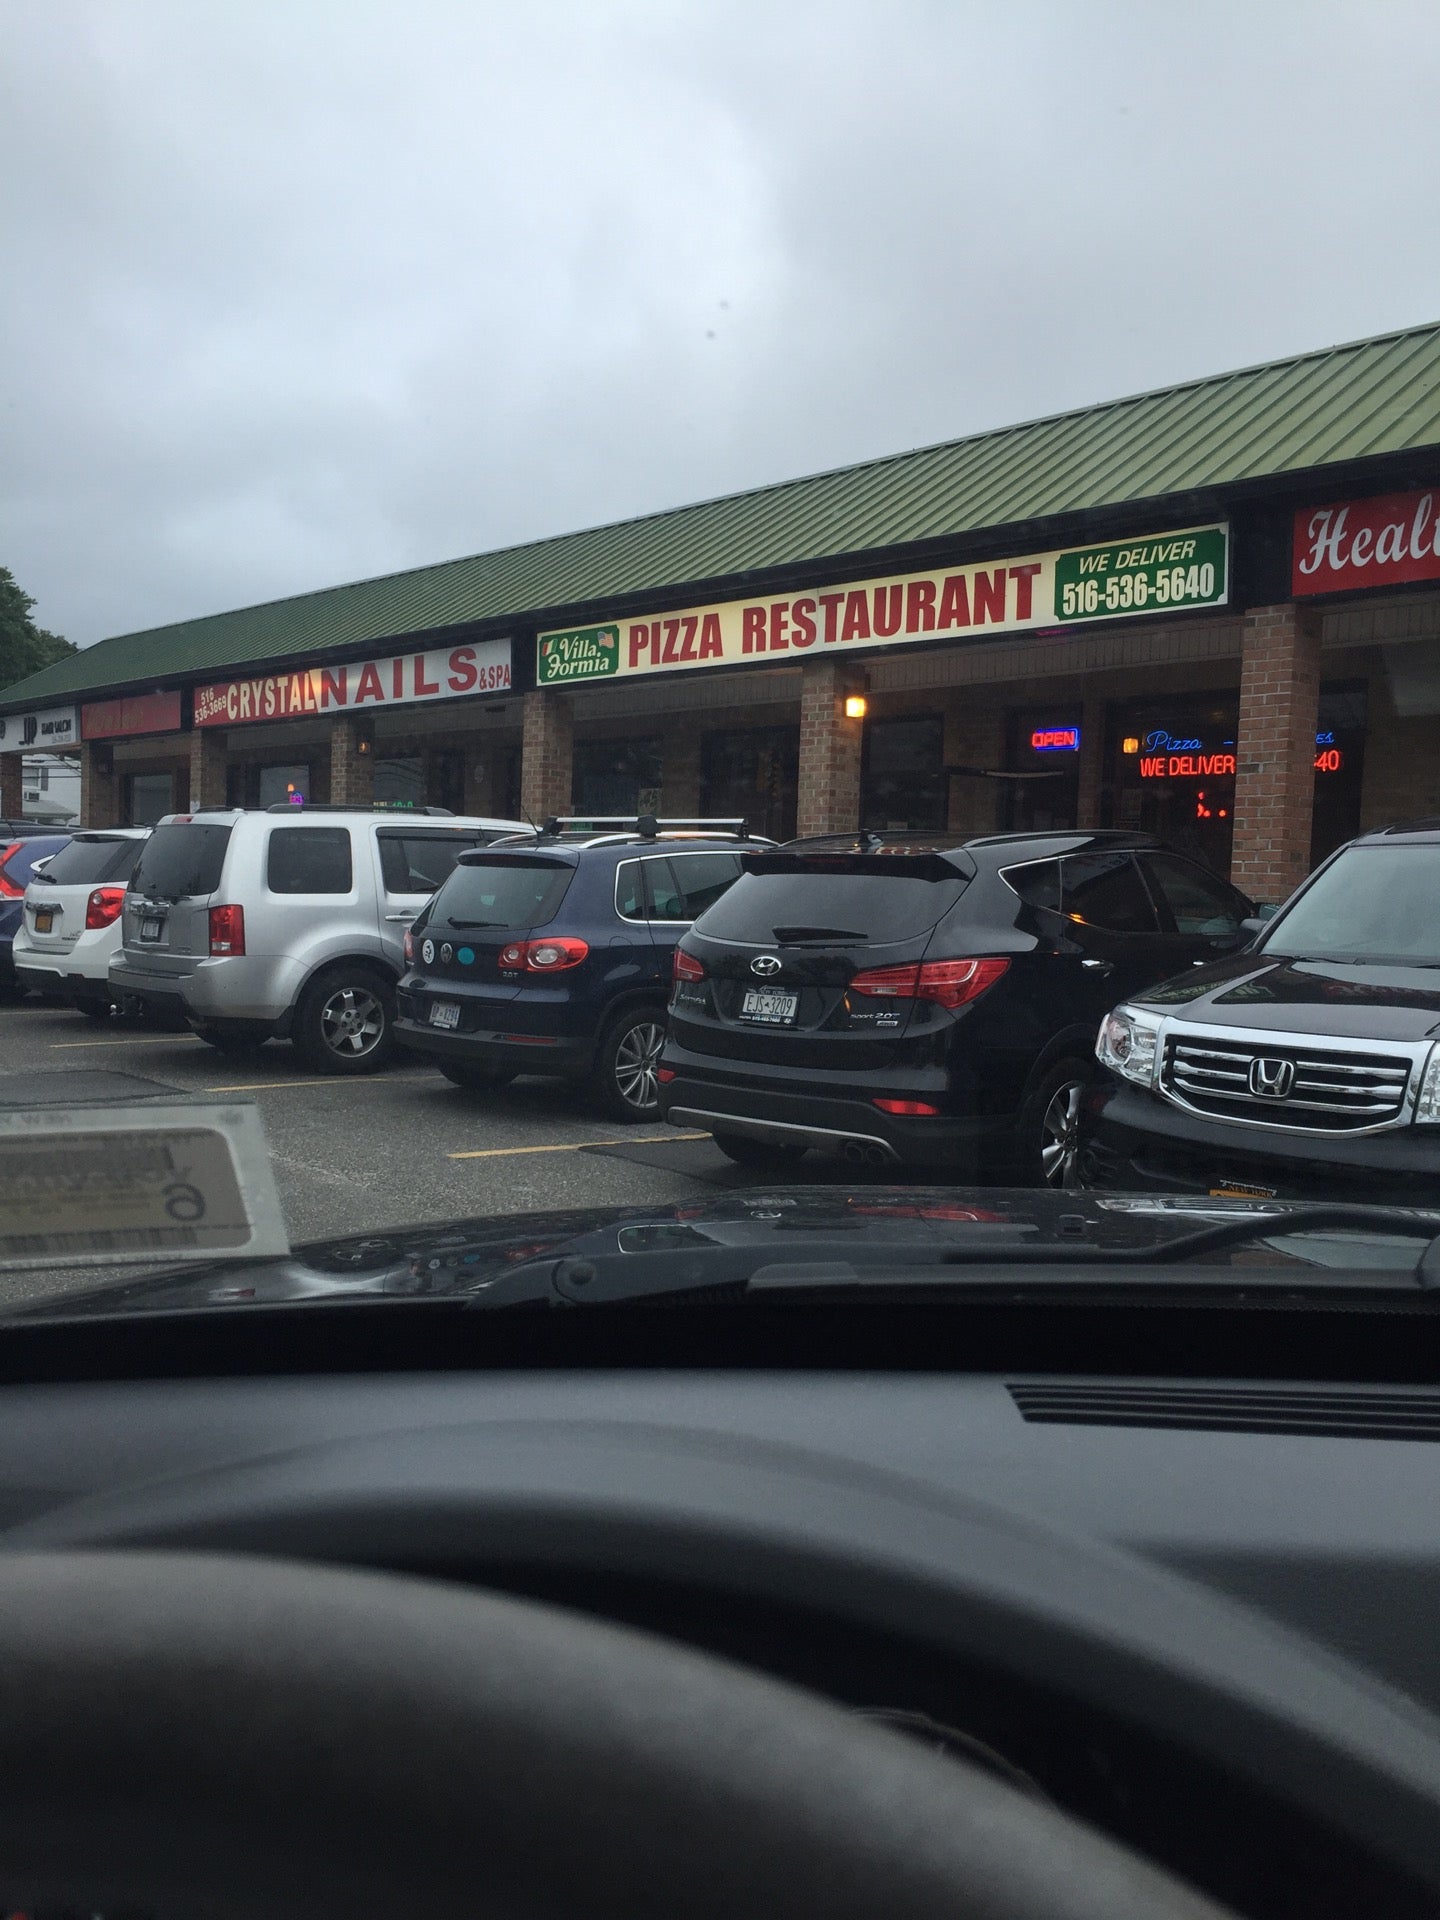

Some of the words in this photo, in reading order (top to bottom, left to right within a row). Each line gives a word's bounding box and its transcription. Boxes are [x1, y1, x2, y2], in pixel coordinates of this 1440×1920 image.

[1079, 553, 1110, 575] WE
[1115, 539, 1197, 569] DELIVER
[1062, 562, 1215, 616] 516-536-5640
[628, 612, 724, 668] PIZZA
[742, 562, 1042, 654] RESTAURANT
[559, 636, 597, 661] Villa
[547, 651, 610, 678] Formia
[201, 687, 214, 706] 516
[227, 672, 316, 720] CRYSTAL
[320, 647, 478, 708] NAILS
[194, 694, 227, 724] 536-3669
[1031, 730, 1075, 747] OPEN
[1145, 730, 1202, 753] Pizza
[1140, 757, 1166, 777] WE
[1168, 754, 1235, 776] DELIVER
